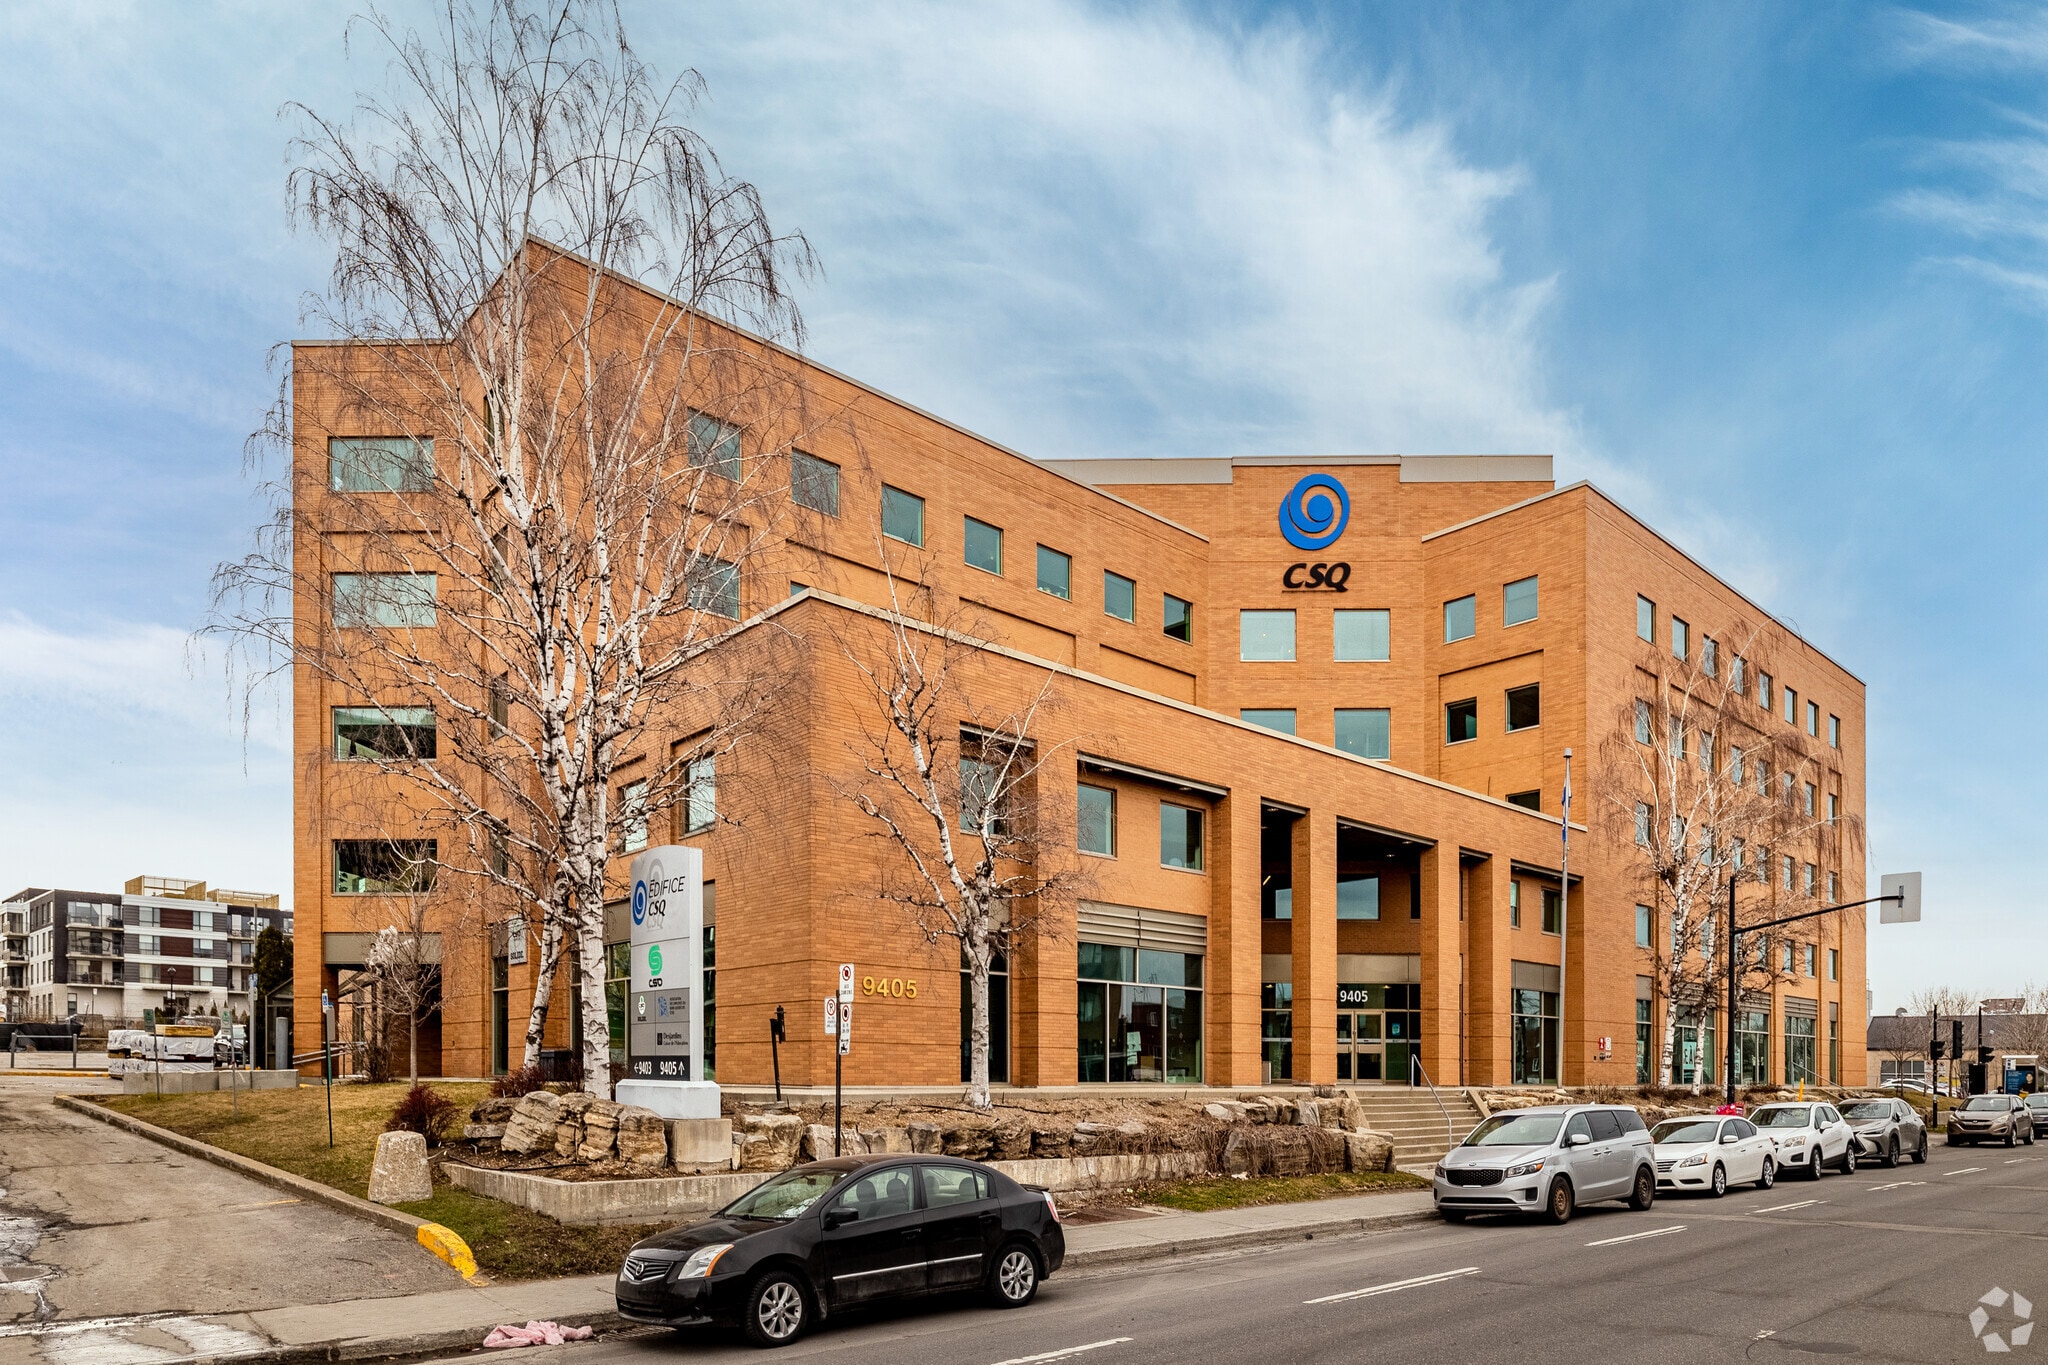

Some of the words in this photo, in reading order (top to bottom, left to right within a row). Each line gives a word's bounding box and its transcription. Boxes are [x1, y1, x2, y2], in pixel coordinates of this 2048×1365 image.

[1282, 562, 1351, 593] CSQ
[648, 876, 685, 898] ÉDIFICE
[648, 899, 666, 916] CSQ
[649, 978, 663, 987] CSD
[862, 976, 918, 999] 9405
[1340, 990, 1368, 1002] 9405
[638, 1061, 652, 1075] 9403
[659, 1061, 677, 1075] 9405
